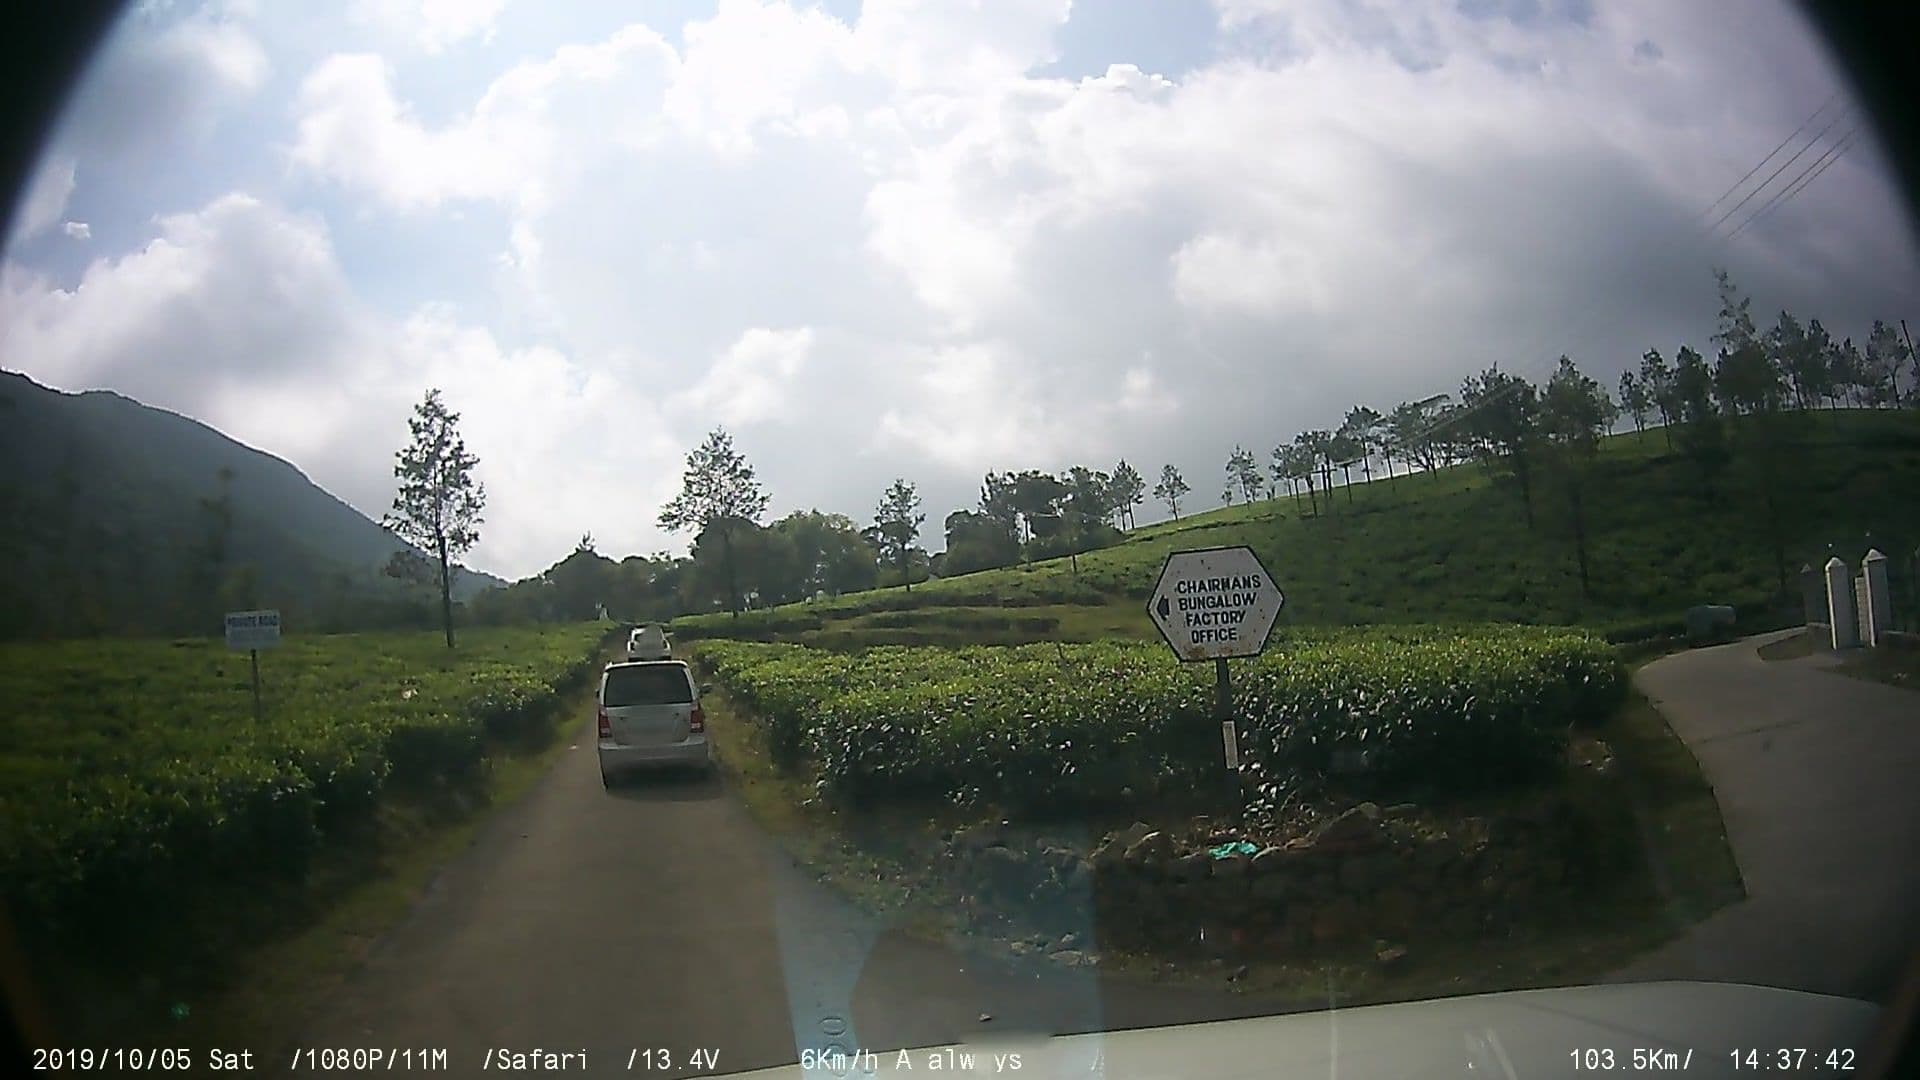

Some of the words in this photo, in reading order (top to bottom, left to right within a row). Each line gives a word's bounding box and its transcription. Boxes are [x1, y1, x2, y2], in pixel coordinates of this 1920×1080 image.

[1176, 575, 1261, 594] CHAIRMANS
[1178, 592, 1257, 611] BUNGALOW
[1186, 610, 1246, 627] FACTORY
[1191, 627, 1237, 644] OFFICE
